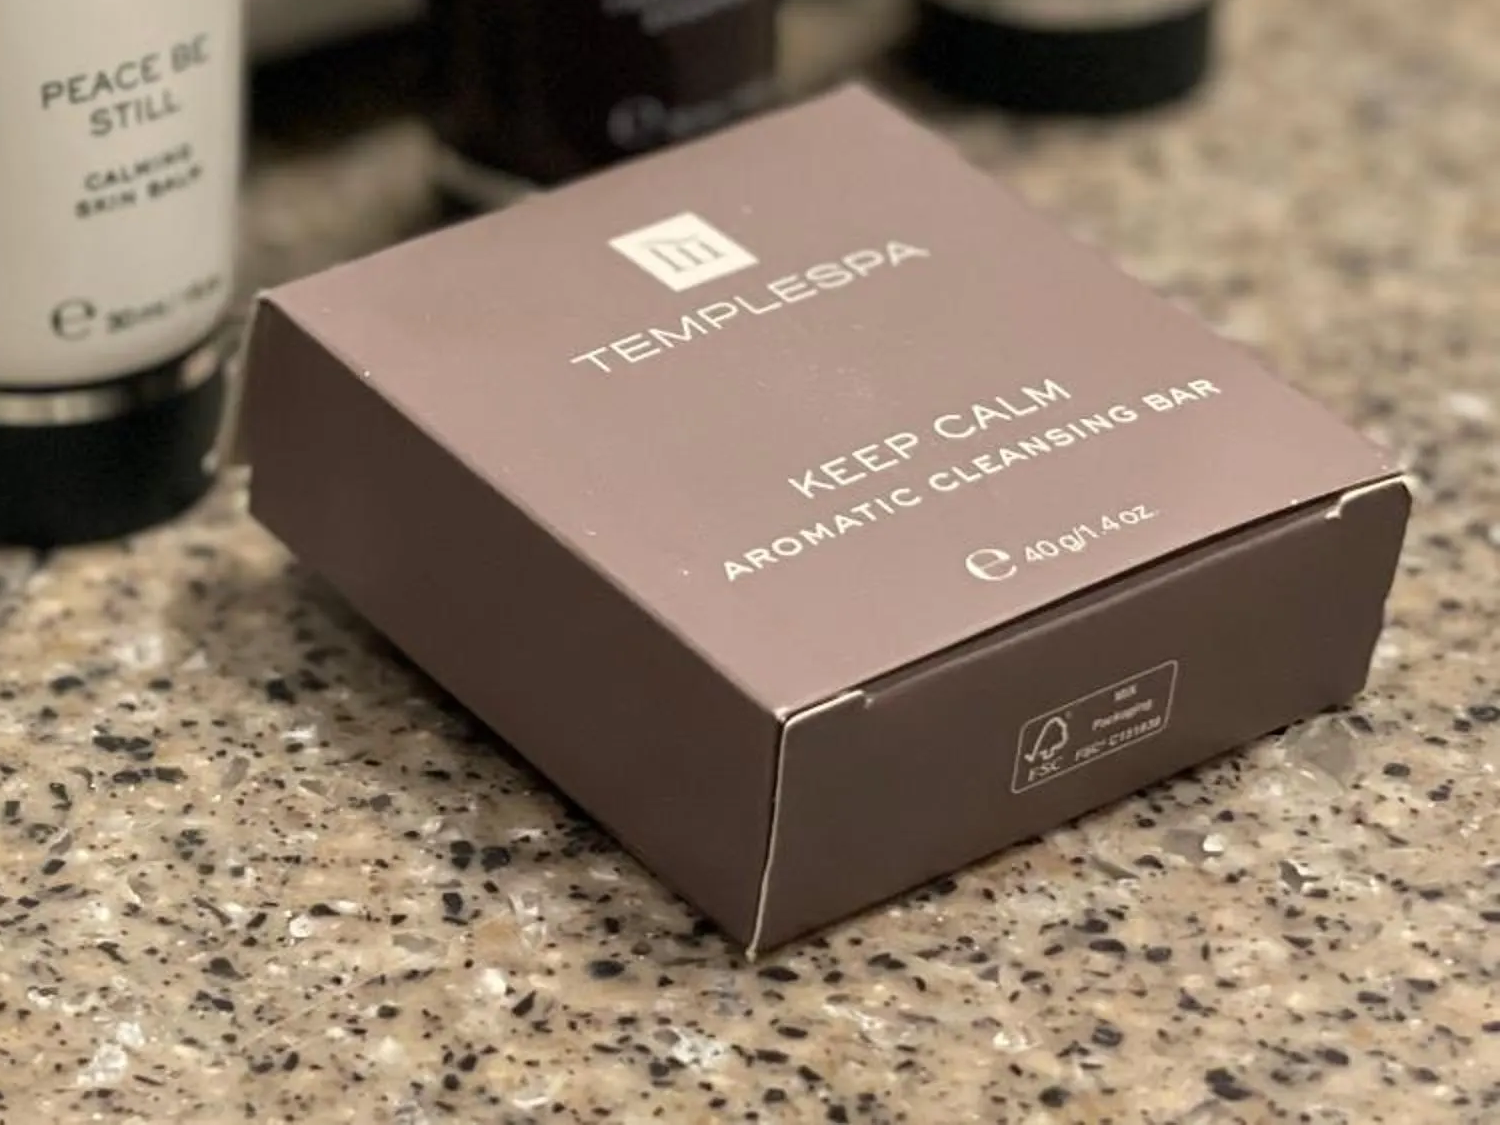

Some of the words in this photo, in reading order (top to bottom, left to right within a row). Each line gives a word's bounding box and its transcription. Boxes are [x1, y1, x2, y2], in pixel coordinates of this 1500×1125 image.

[40, 52, 162, 111] PEACE
[170, 33, 210, 73] BE
[89, 88, 182, 137] STILL
[569, 240, 931, 373] TEMPLESPA
[723, 488, 923, 582] AROMATIC
[928, 404, 1138, 492] CLEANSING
[1142, 378, 1222, 412] BAR
[787, 432, 920, 500] KEEP
[933, 378, 1073, 439] CALM
